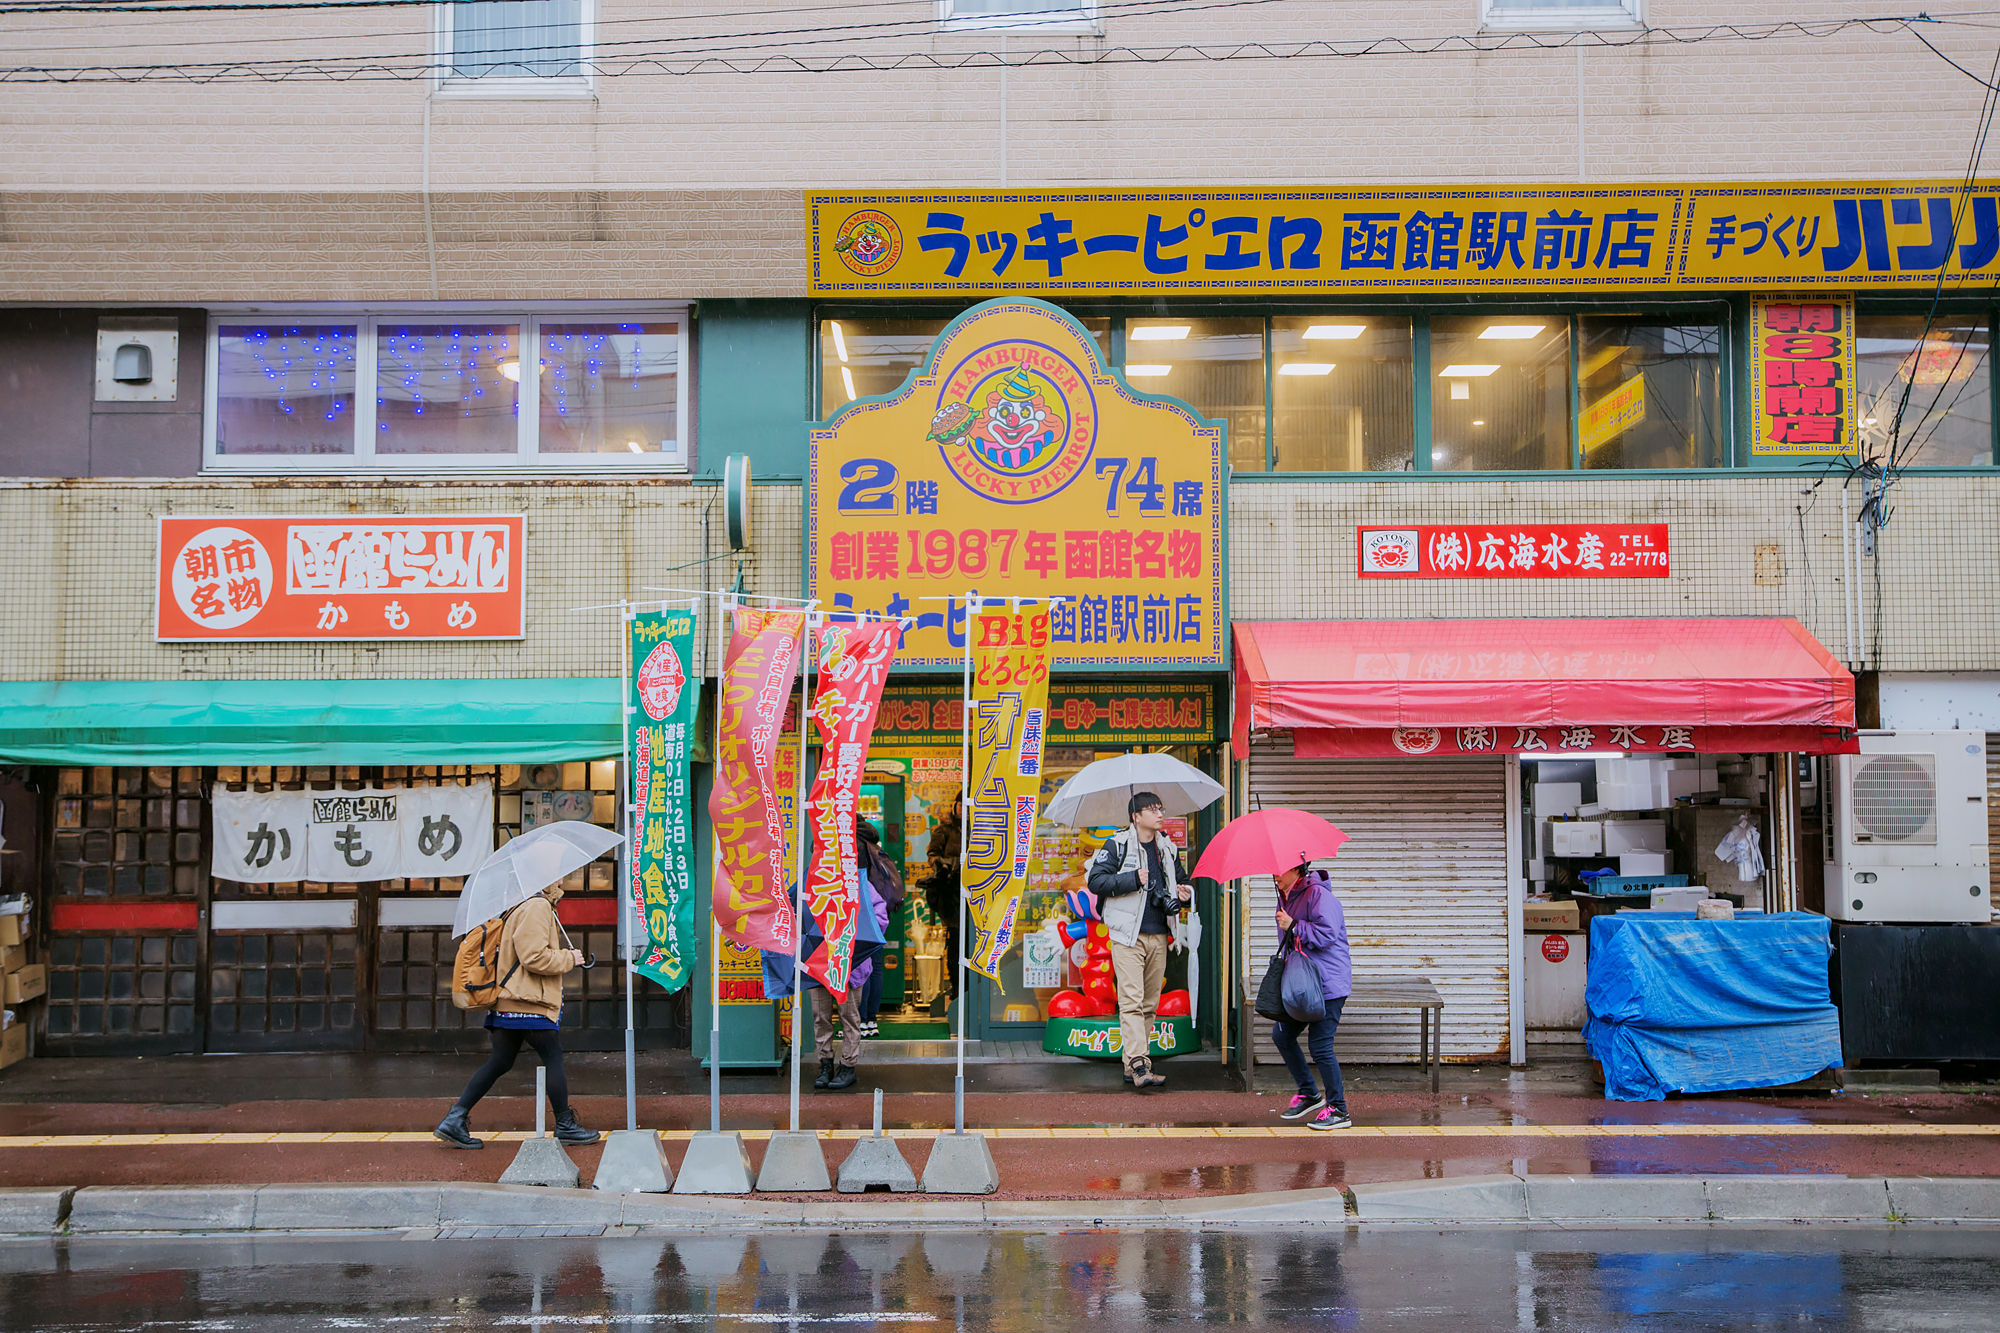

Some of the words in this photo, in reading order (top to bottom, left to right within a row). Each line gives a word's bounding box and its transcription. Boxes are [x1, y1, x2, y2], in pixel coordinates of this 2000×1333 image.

[842, 213, 896, 234] HAMBURGER
[1341, 208, 1660, 272] 函館駅前店
[844, 255, 873, 274] LUCKY
[874, 239, 901, 273] PIERROT
[950, 346, 1080, 401] HAMBURGER
[1763, 302, 1843, 445] 朝8時開店
[953, 449, 1021, 498] LUCKY
[1028, 411, 1092, 496] PIERROT
[837, 458, 939, 517] 2階
[1095, 457, 1203, 518] 74席
[183, 539, 258, 583] 朝市
[1369, 533, 1413, 551] KOTONE
[1610, 551, 1668, 567] 22-7778
[1620, 535, 1655, 547] TEL
[190, 576, 264, 620] 名物
[977, 614, 1050, 651] Big
[977, 653, 1047, 686] とろとろ
